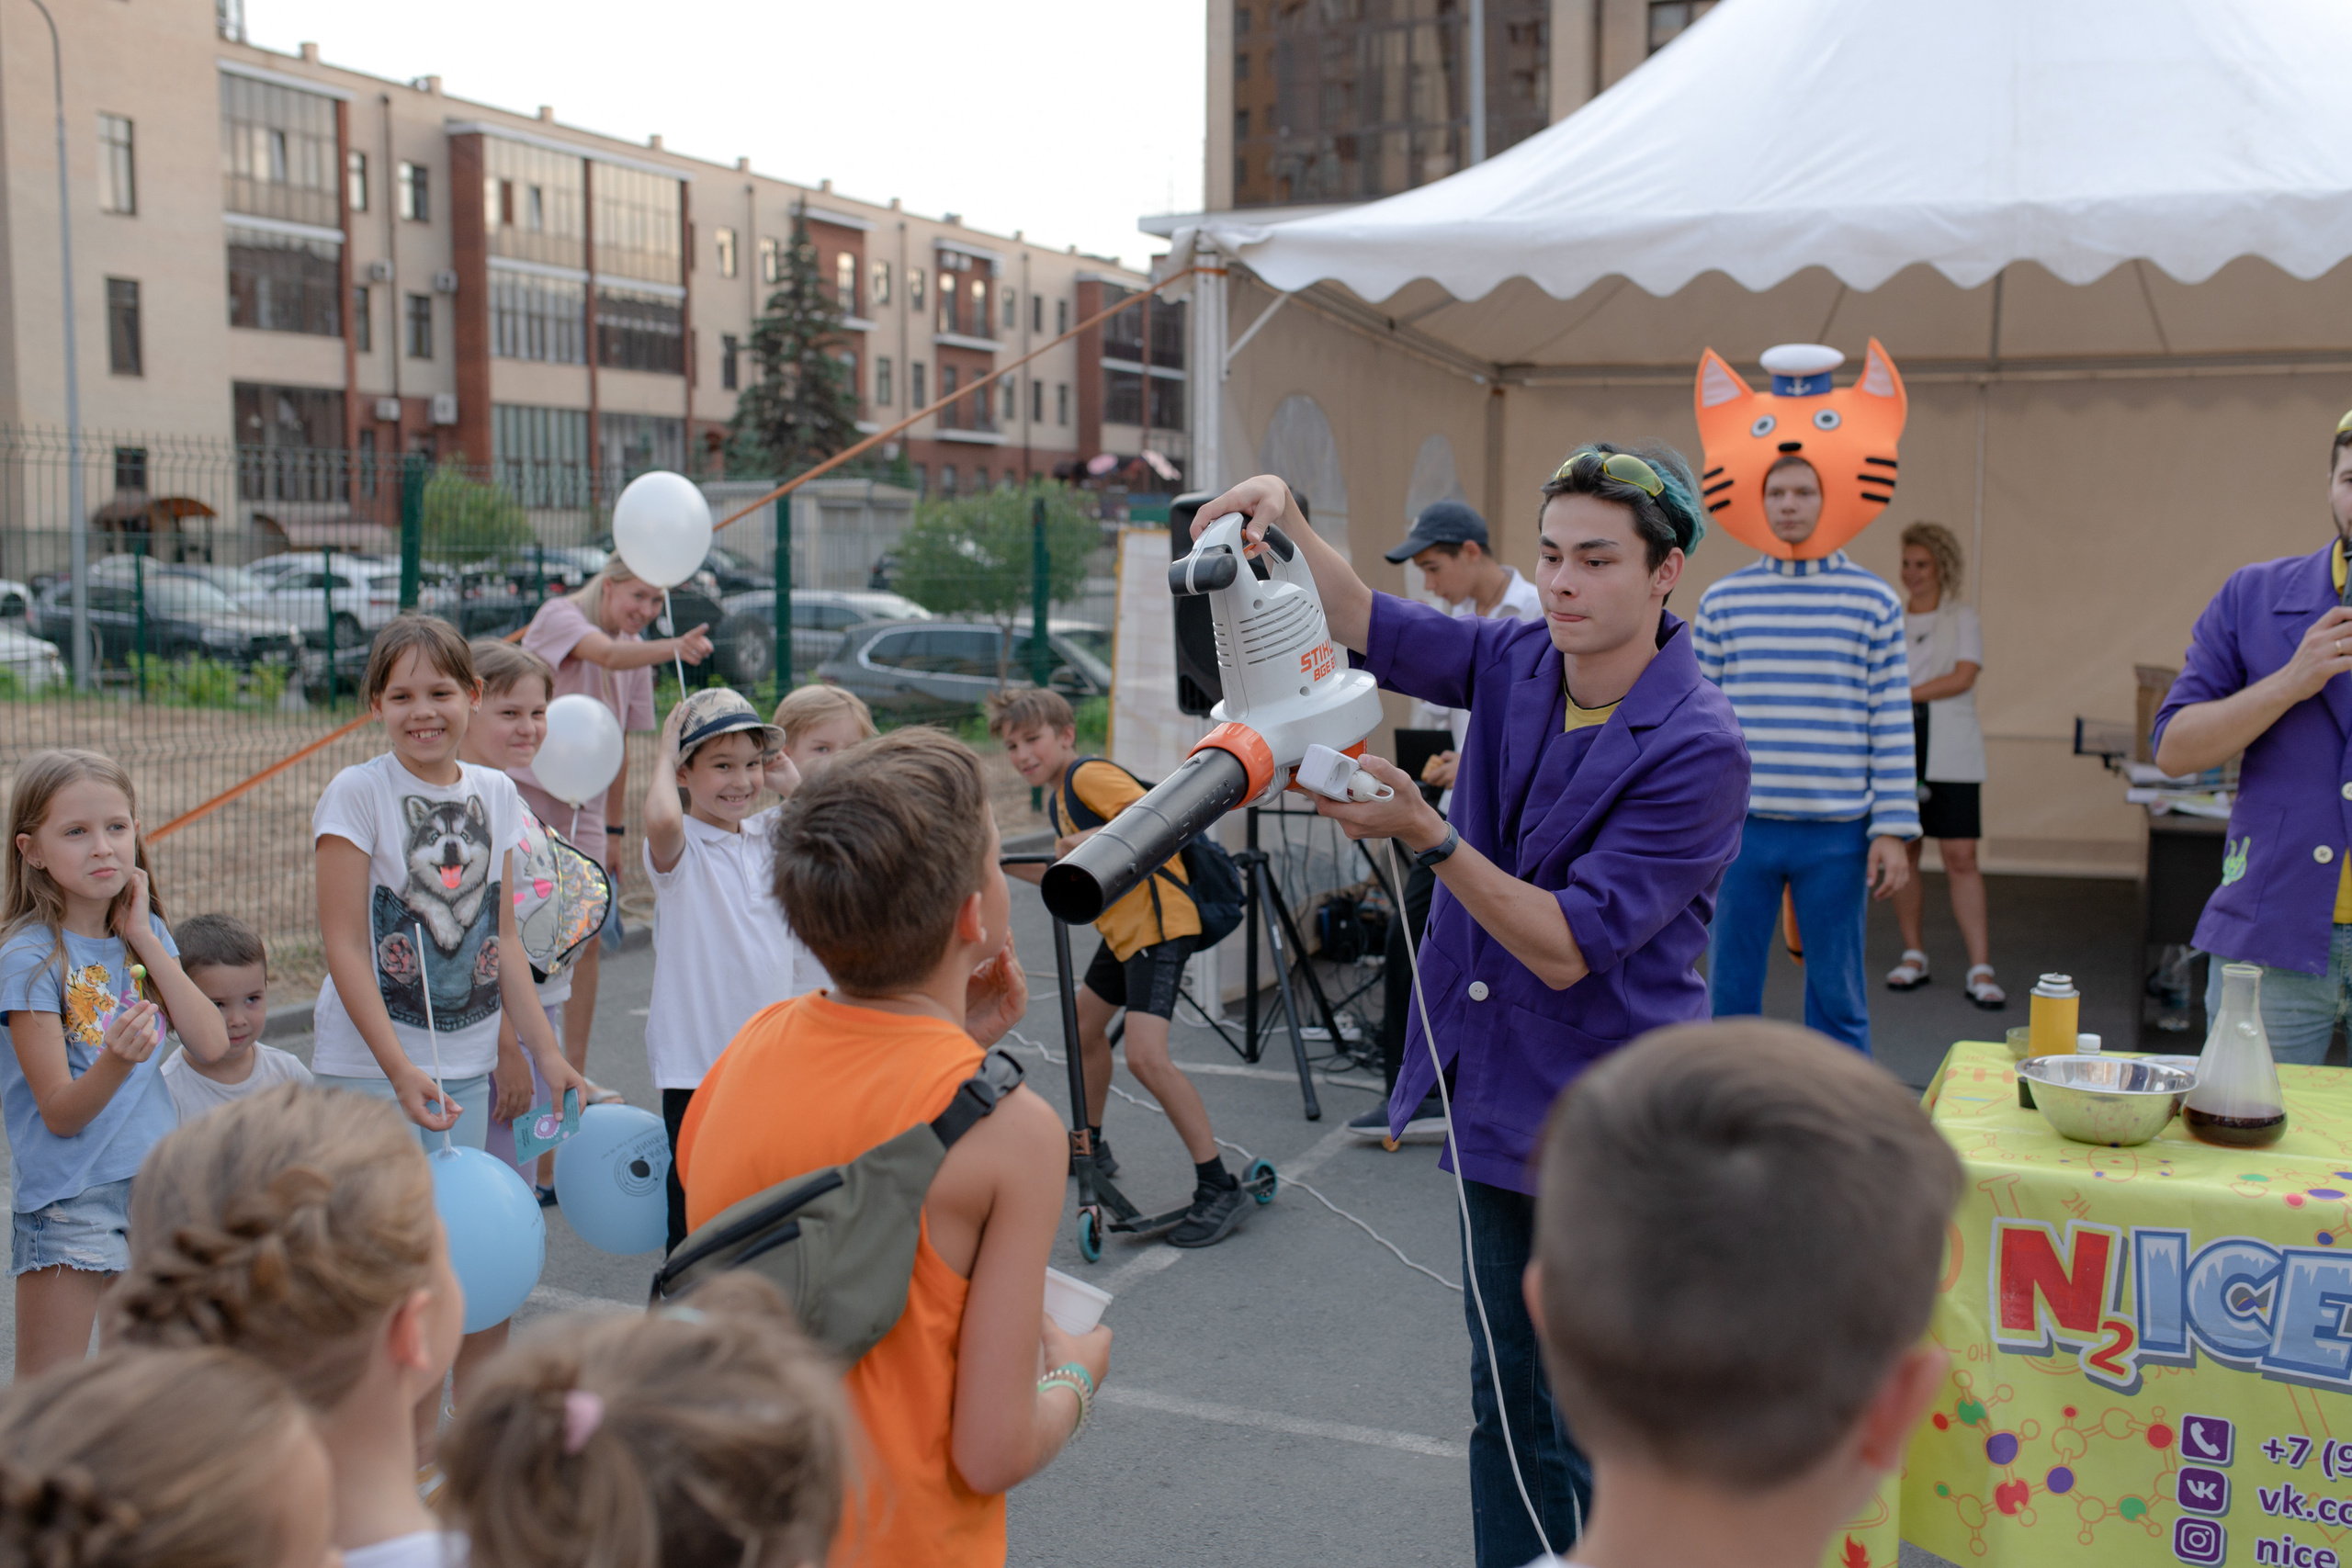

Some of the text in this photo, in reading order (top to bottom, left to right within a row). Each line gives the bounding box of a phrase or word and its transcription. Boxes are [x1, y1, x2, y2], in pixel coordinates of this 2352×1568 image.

[1300, 637, 1333, 674] STIHL
[1314, 660, 1331, 682] BGE
[632, 1131, 668, 1156] НАНИЙ
[1967, 1343, 1992, 1363] OH
[2261, 1436, 2312, 1467] +7
[2257, 1483, 2352, 1526] vk.co
[2256, 1535, 2337, 1568] nice
